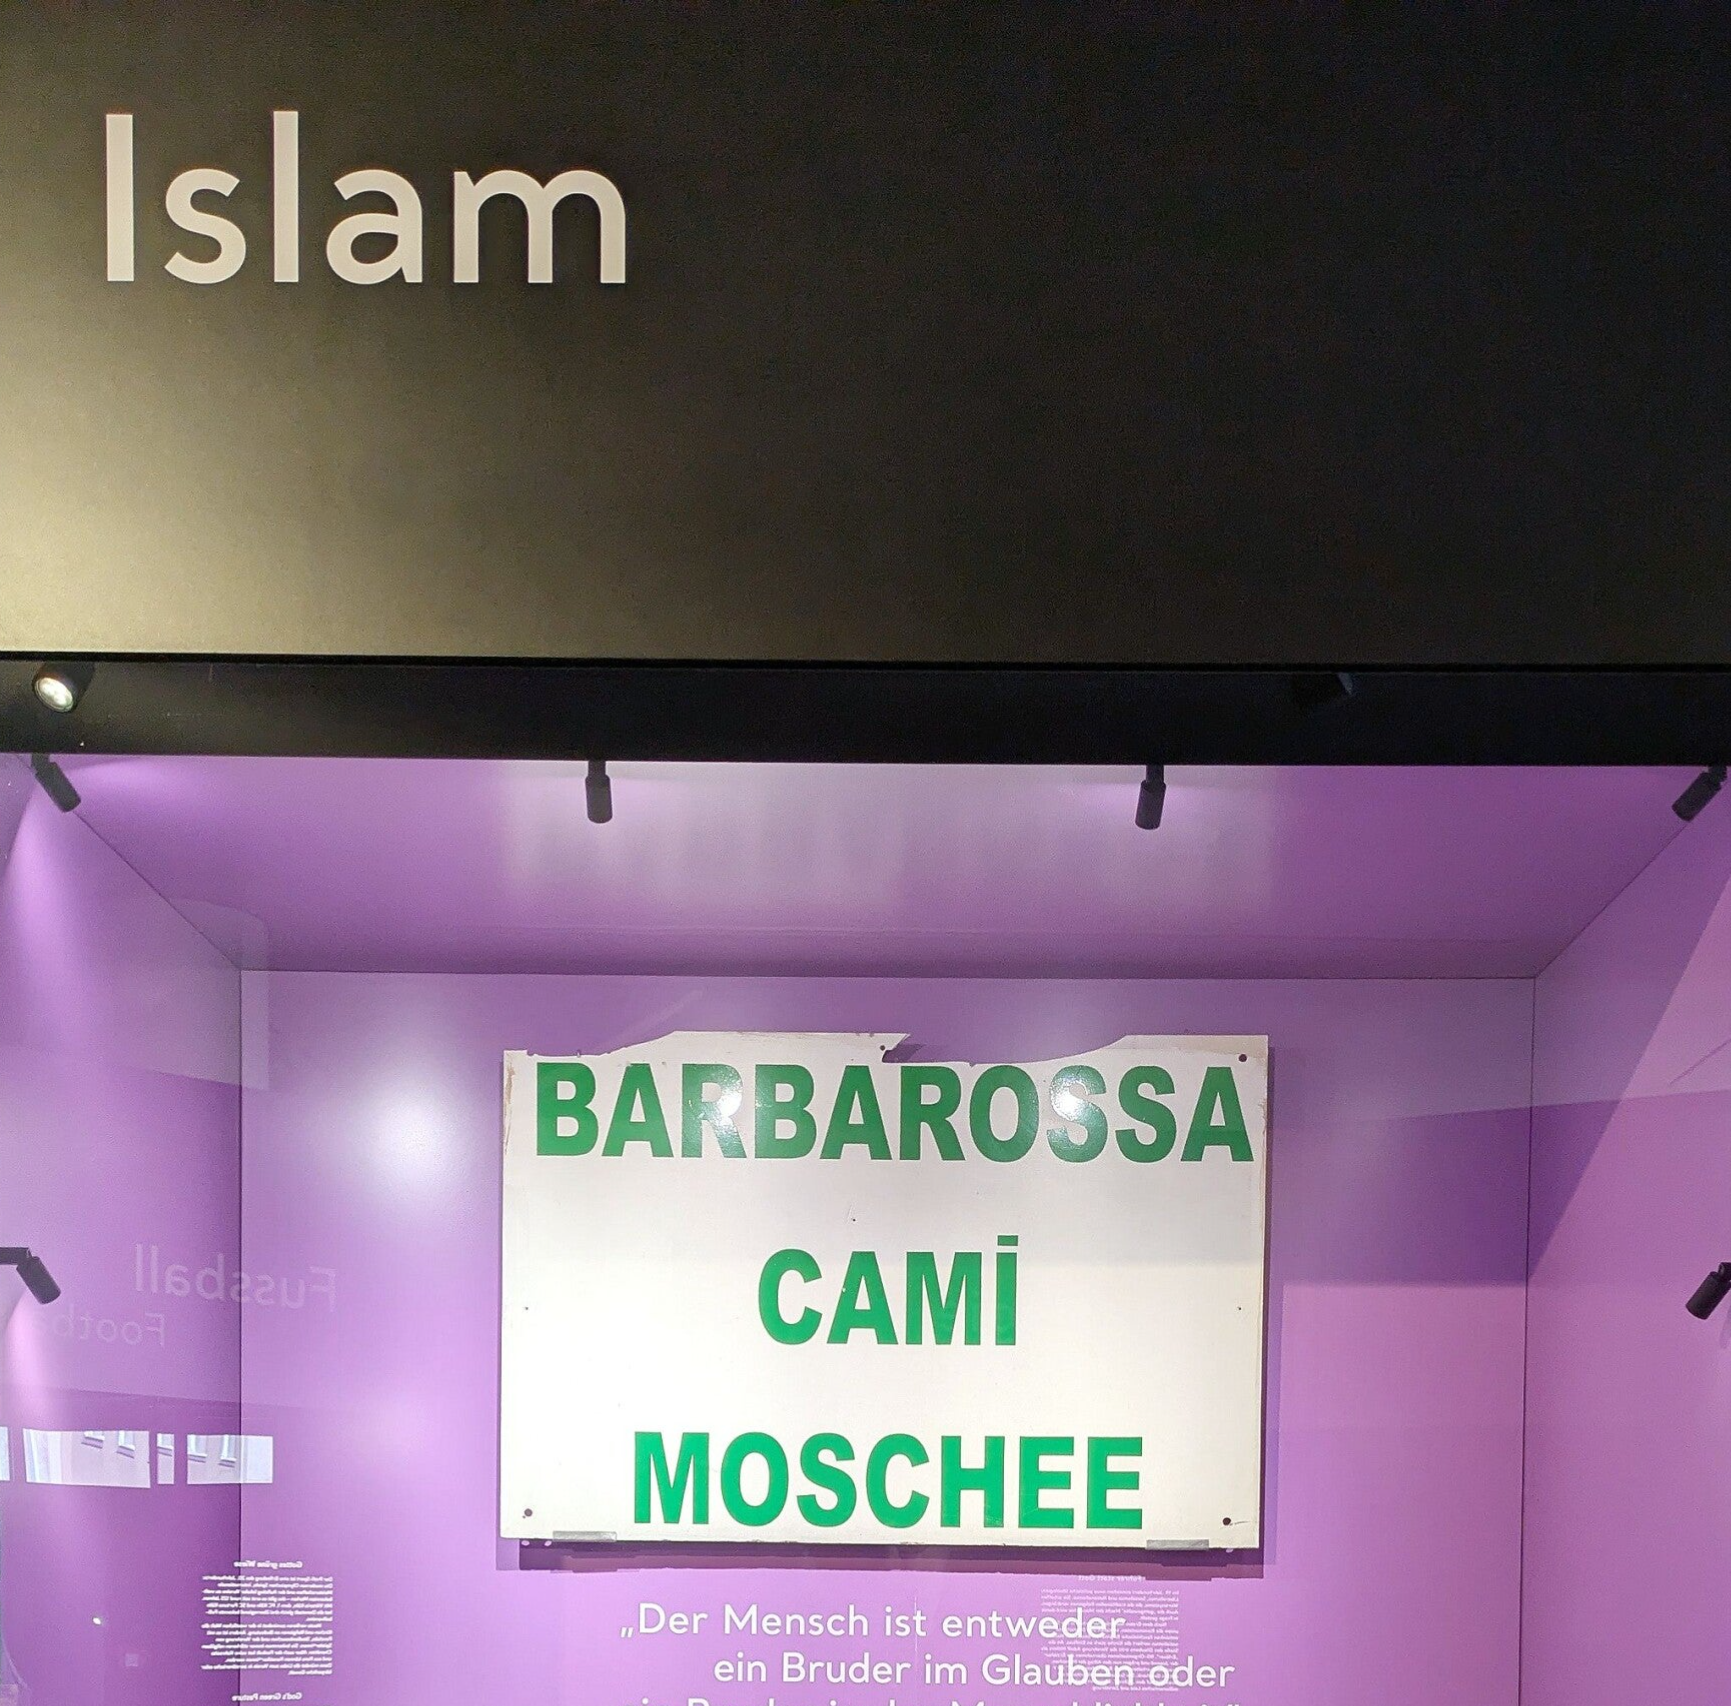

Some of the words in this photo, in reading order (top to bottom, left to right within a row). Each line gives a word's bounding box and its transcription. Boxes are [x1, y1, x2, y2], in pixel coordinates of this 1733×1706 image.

[105, 110, 627, 285] Islam
[536, 1062, 1254, 1162] BARBAROSSA
[758, 1234, 1020, 1346] CAMİ
[633, 1430, 1143, 1530] MOSCHEE
[714, 1651, 767, 1682] ein
[783, 1651, 911, 1684] Bruder
[925, 1653, 967, 1684] im
[982, 1653, 1134, 1686] Glauben
[1149, 1655, 1235, 1687] oder
[724, 1603, 869, 1636] Mensch
[885, 1605, 927, 1637] ist
[942, 1606, 1126, 1639] entweder
